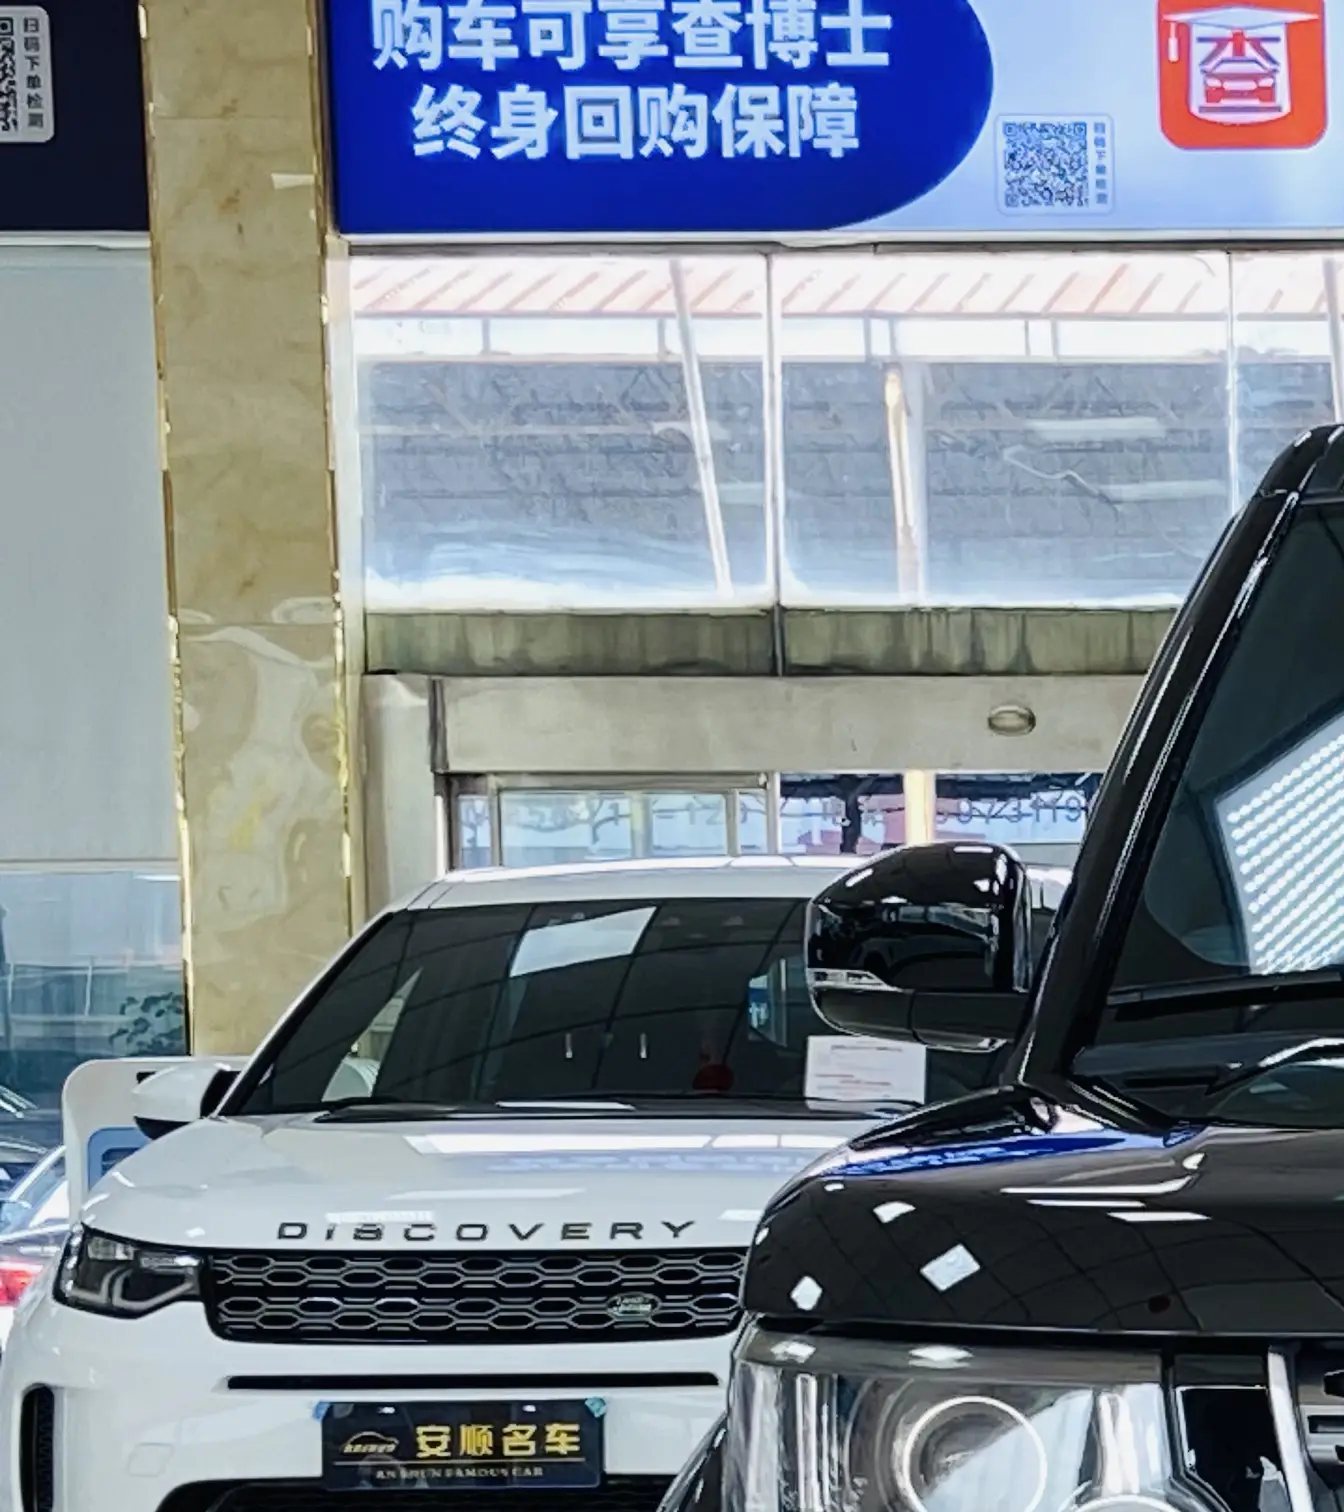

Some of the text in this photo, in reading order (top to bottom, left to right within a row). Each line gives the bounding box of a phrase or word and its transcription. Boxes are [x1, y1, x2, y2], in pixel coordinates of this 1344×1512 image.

[371, 0, 893, 71] 购车可享查博士
[412, 83, 860, 160] 终身回购保障
[277, 1221, 696, 1241] DISCOVERY
[415, 1423, 580, 1458] 安顺名车
